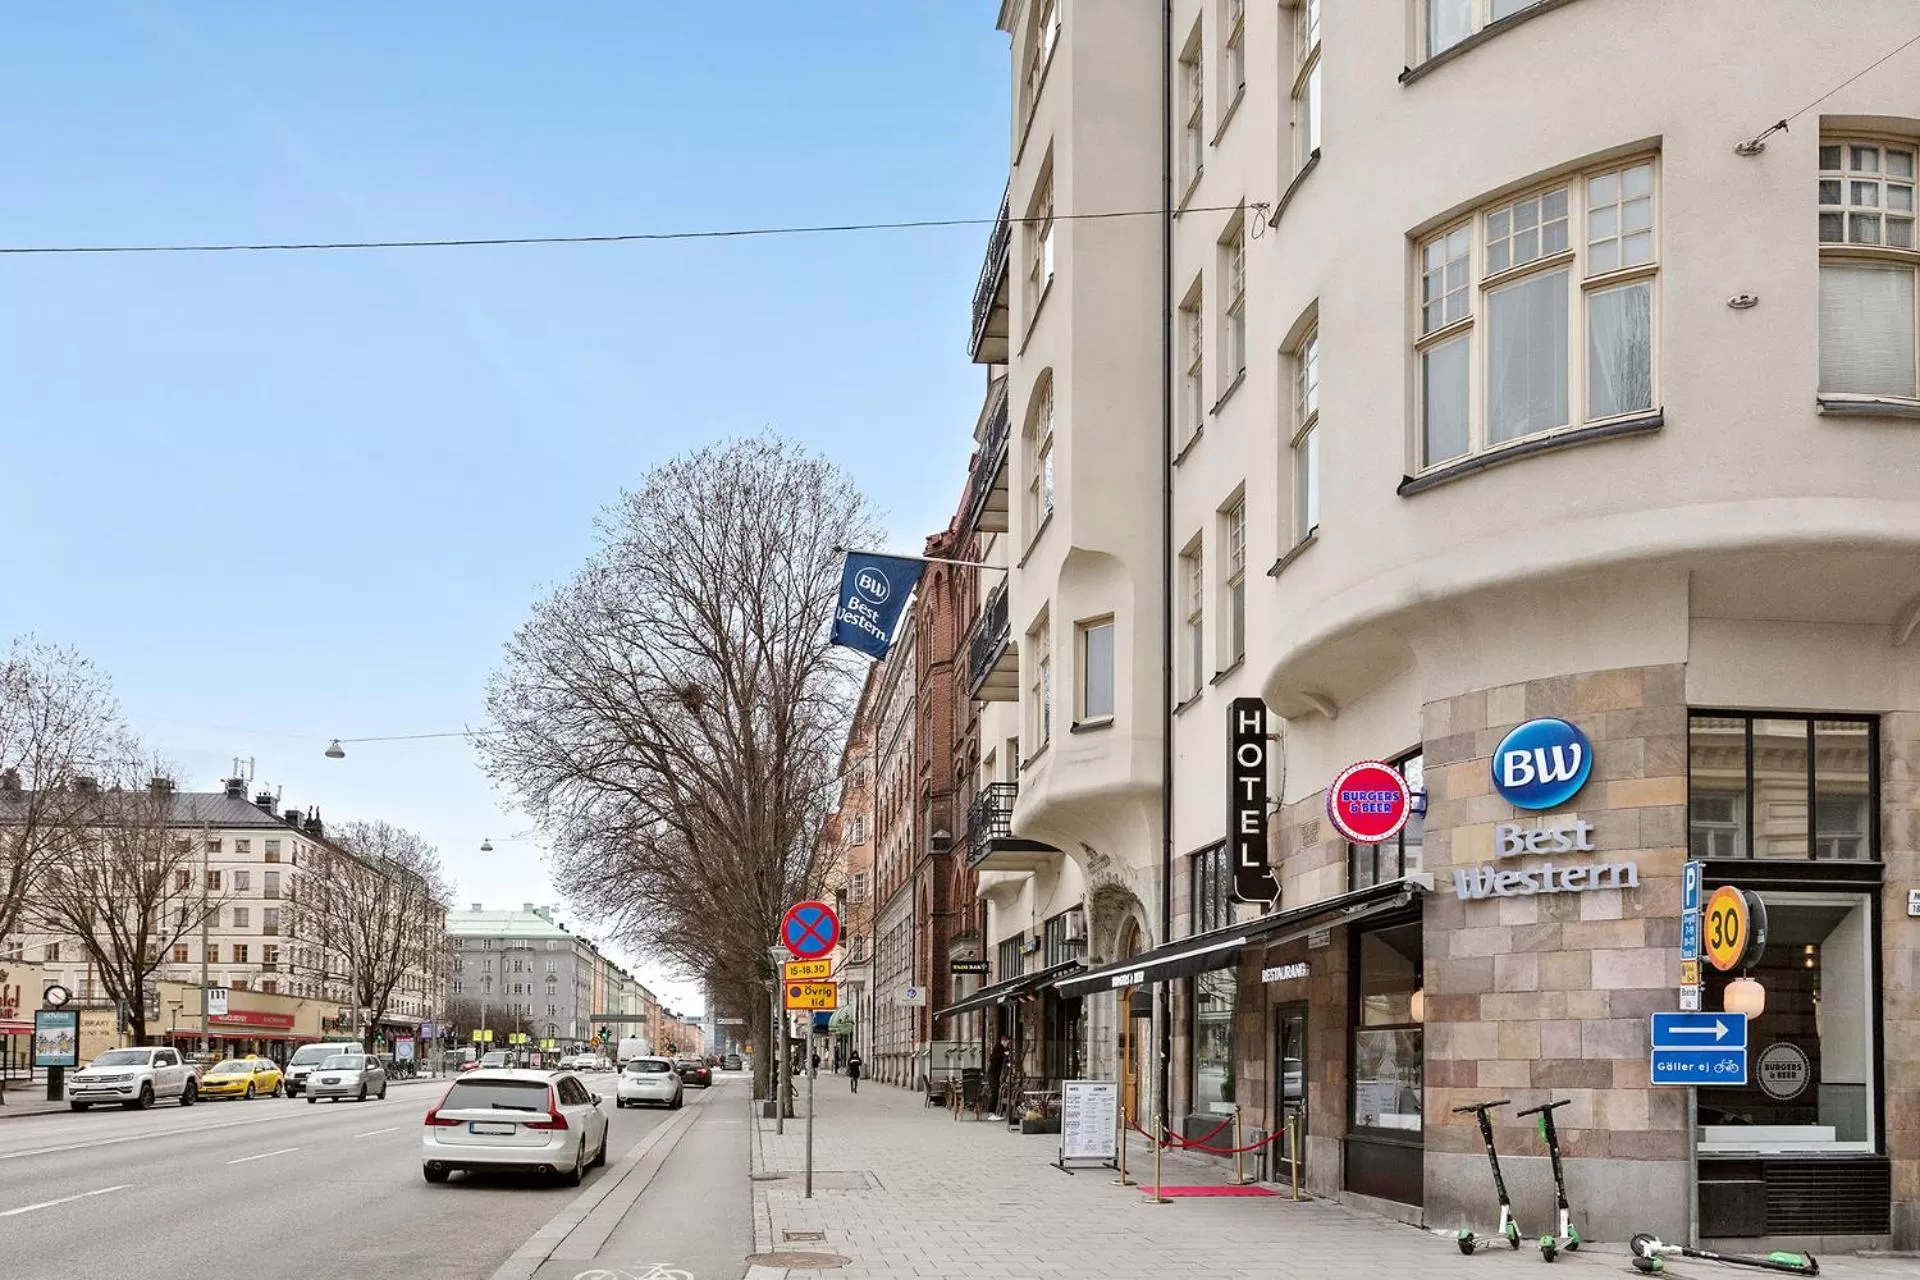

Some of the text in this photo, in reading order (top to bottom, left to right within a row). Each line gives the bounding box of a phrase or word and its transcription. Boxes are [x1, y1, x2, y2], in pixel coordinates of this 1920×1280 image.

[859, 574, 887, 598] BW
[848, 596, 880, 624] Best
[1503, 743, 1582, 787] BW
[1237, 709, 1263, 868] HOTEL
[1342, 792, 1400, 802] BURGERS
[1350, 803, 1392, 813] & BEER
[1495, 820, 1595, 857] Best
[1453, 861, 1640, 900] Western
[1685, 867, 1696, 906] P
[1710, 907, 1739, 949] 30
[790, 965, 825, 976] 15-18.30
[804, 985, 832, 998] Övrig
[811, 998, 825, 1007] tid
[1657, 1061, 1710, 1073] Gäller ej
[1764, 1063, 1802, 1071] BURGERS
